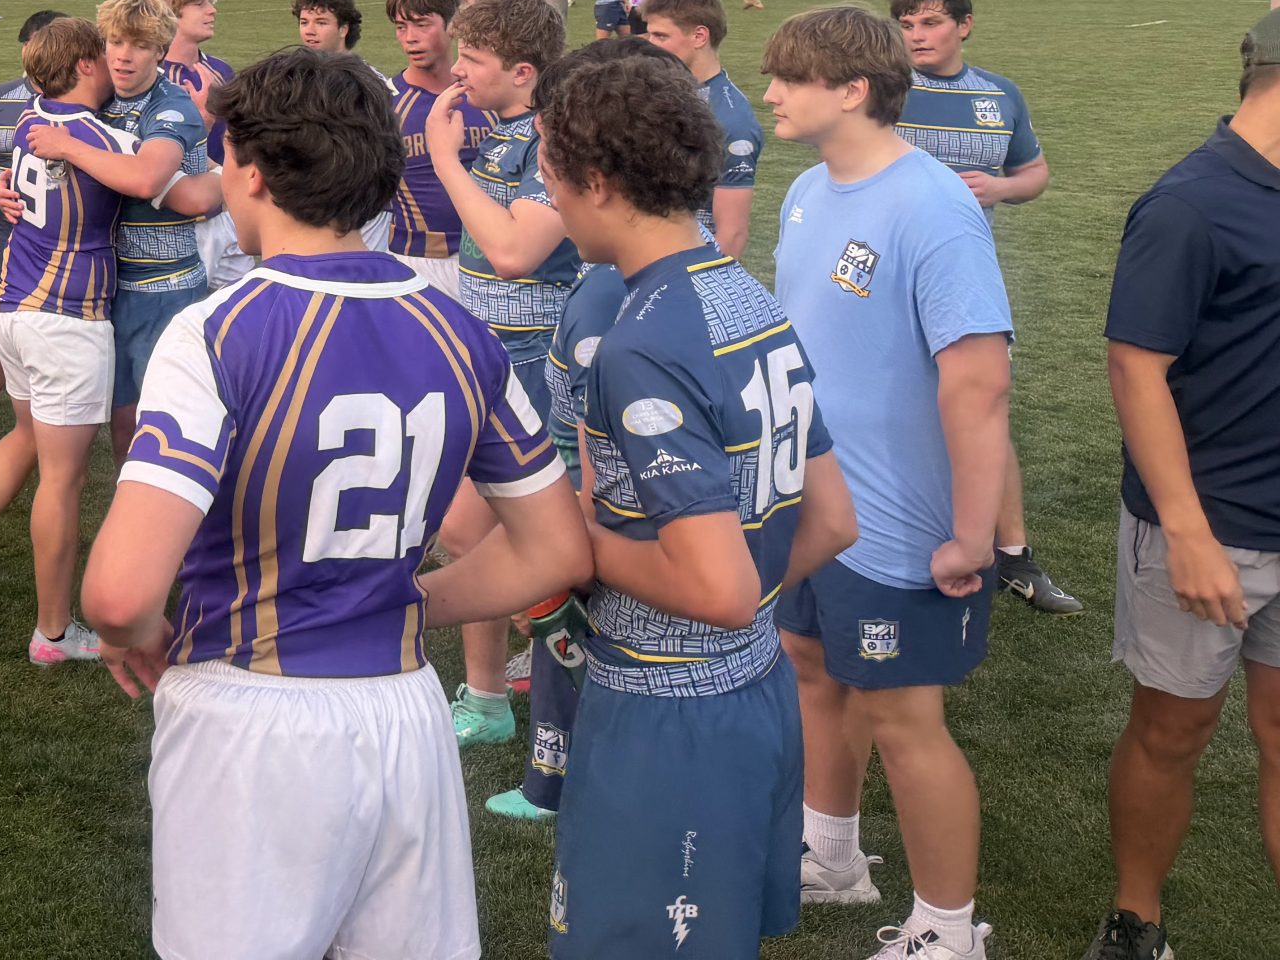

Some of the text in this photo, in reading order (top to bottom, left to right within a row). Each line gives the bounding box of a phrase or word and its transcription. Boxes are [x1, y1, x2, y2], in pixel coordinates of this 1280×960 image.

[10, 145, 47, 229] 19
[639, 400, 653, 410] 13
[740, 342, 814, 514] 15
[302, 392, 445, 562] 21
[639, 462, 702, 481] KIA KAHA
[546, 627, 586, 668] G
